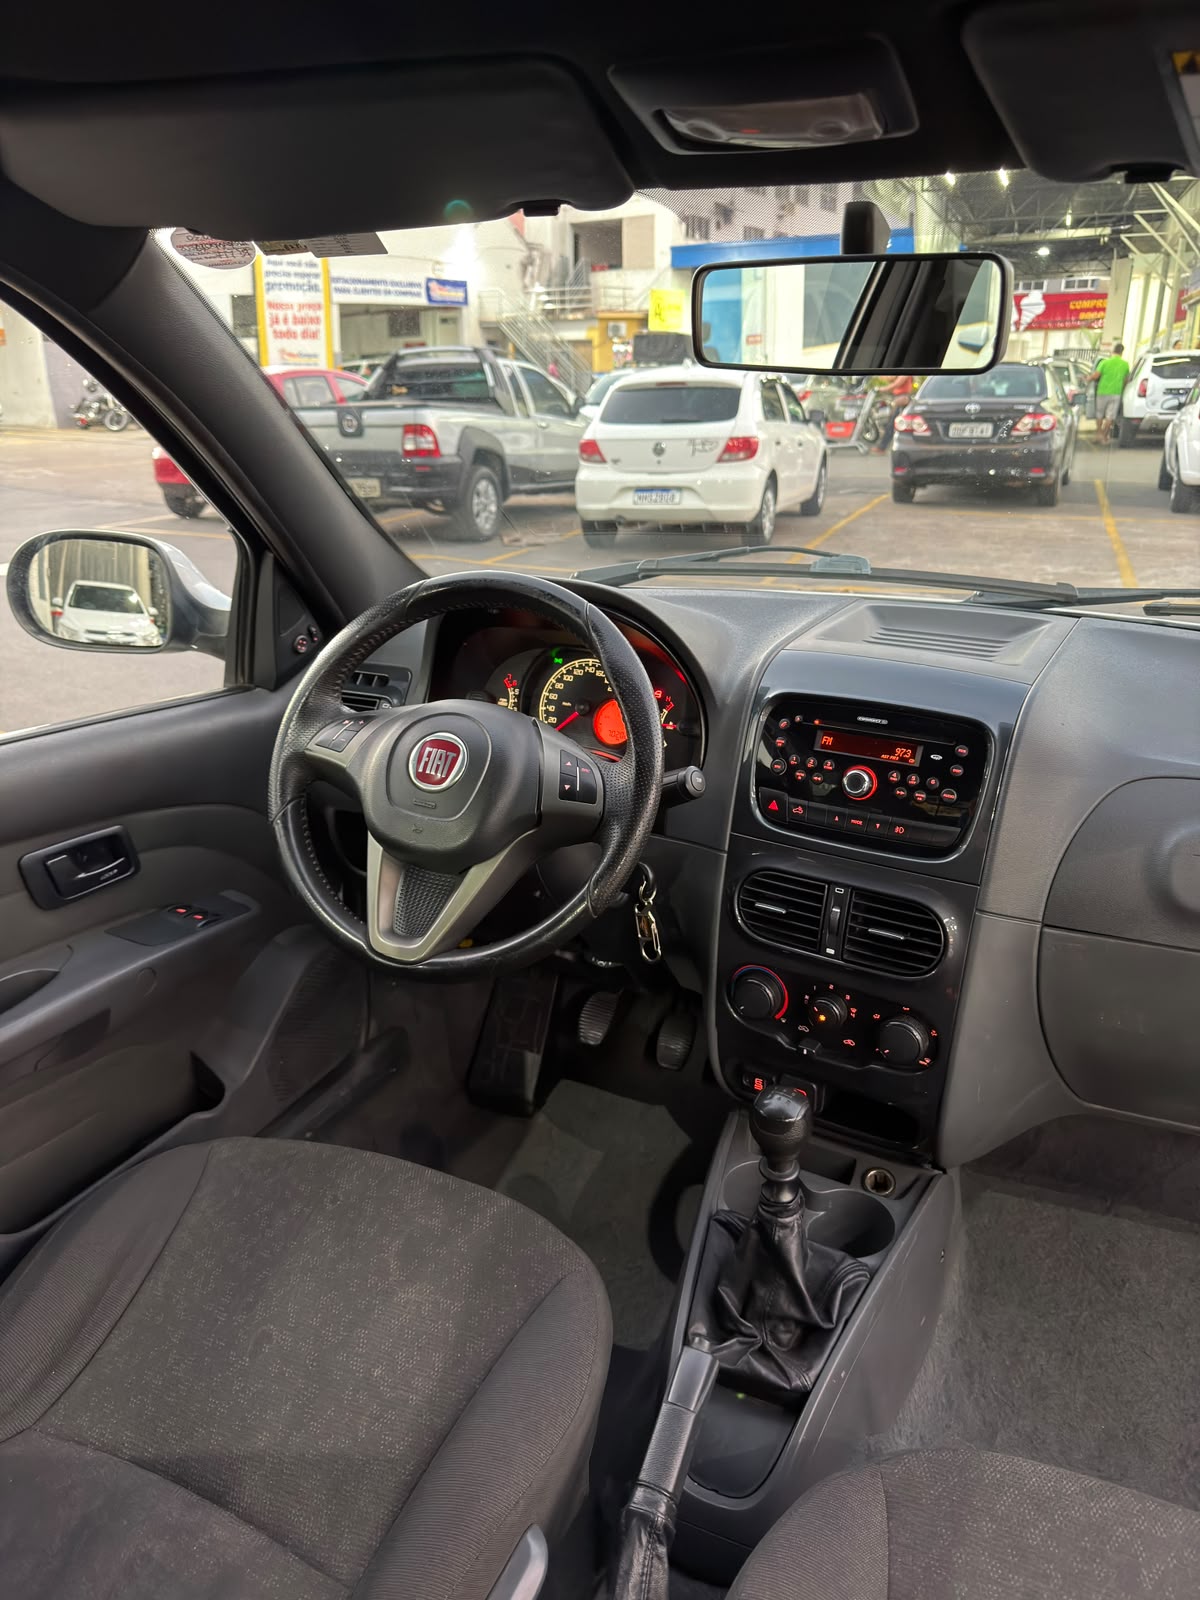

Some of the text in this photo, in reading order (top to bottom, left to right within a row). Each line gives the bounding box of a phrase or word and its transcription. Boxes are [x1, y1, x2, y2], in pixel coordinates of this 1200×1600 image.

[292, 313, 321, 325] baixo
[272, 328, 297, 340] todo
[554, 682, 564, 690] 80
[547, 716, 557, 724] 20
[821, 736, 833, 746] FM
[417, 746, 457, 778] FIAT
